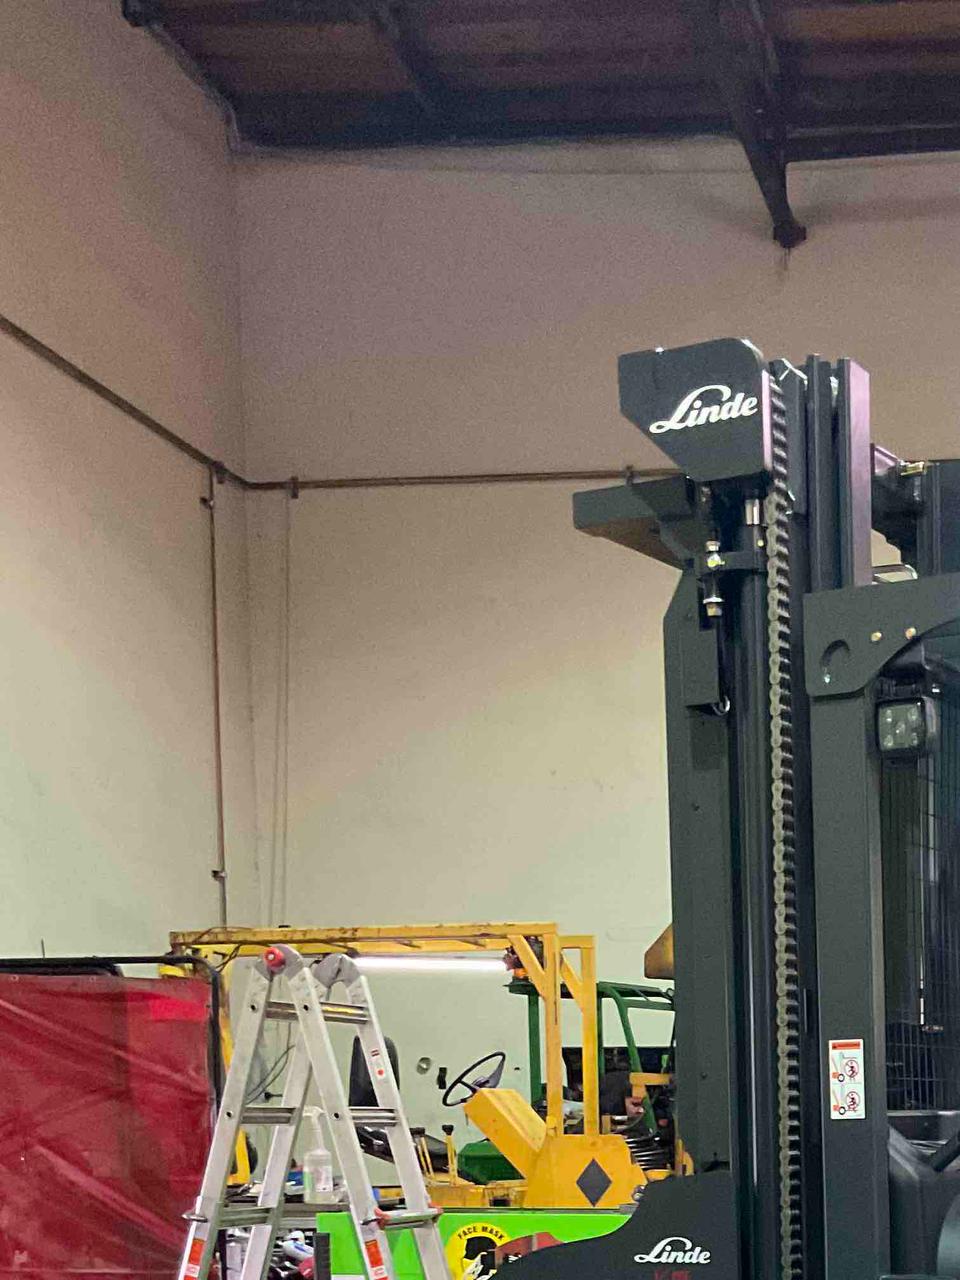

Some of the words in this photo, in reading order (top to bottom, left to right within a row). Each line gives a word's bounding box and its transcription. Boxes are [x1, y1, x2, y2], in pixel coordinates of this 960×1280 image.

[650, 384, 758, 433] Linde
[458, 1226, 477, 1239] FACE
[482, 1226, 505, 1240] MASK
[634, 1236, 711, 1264] Linde
